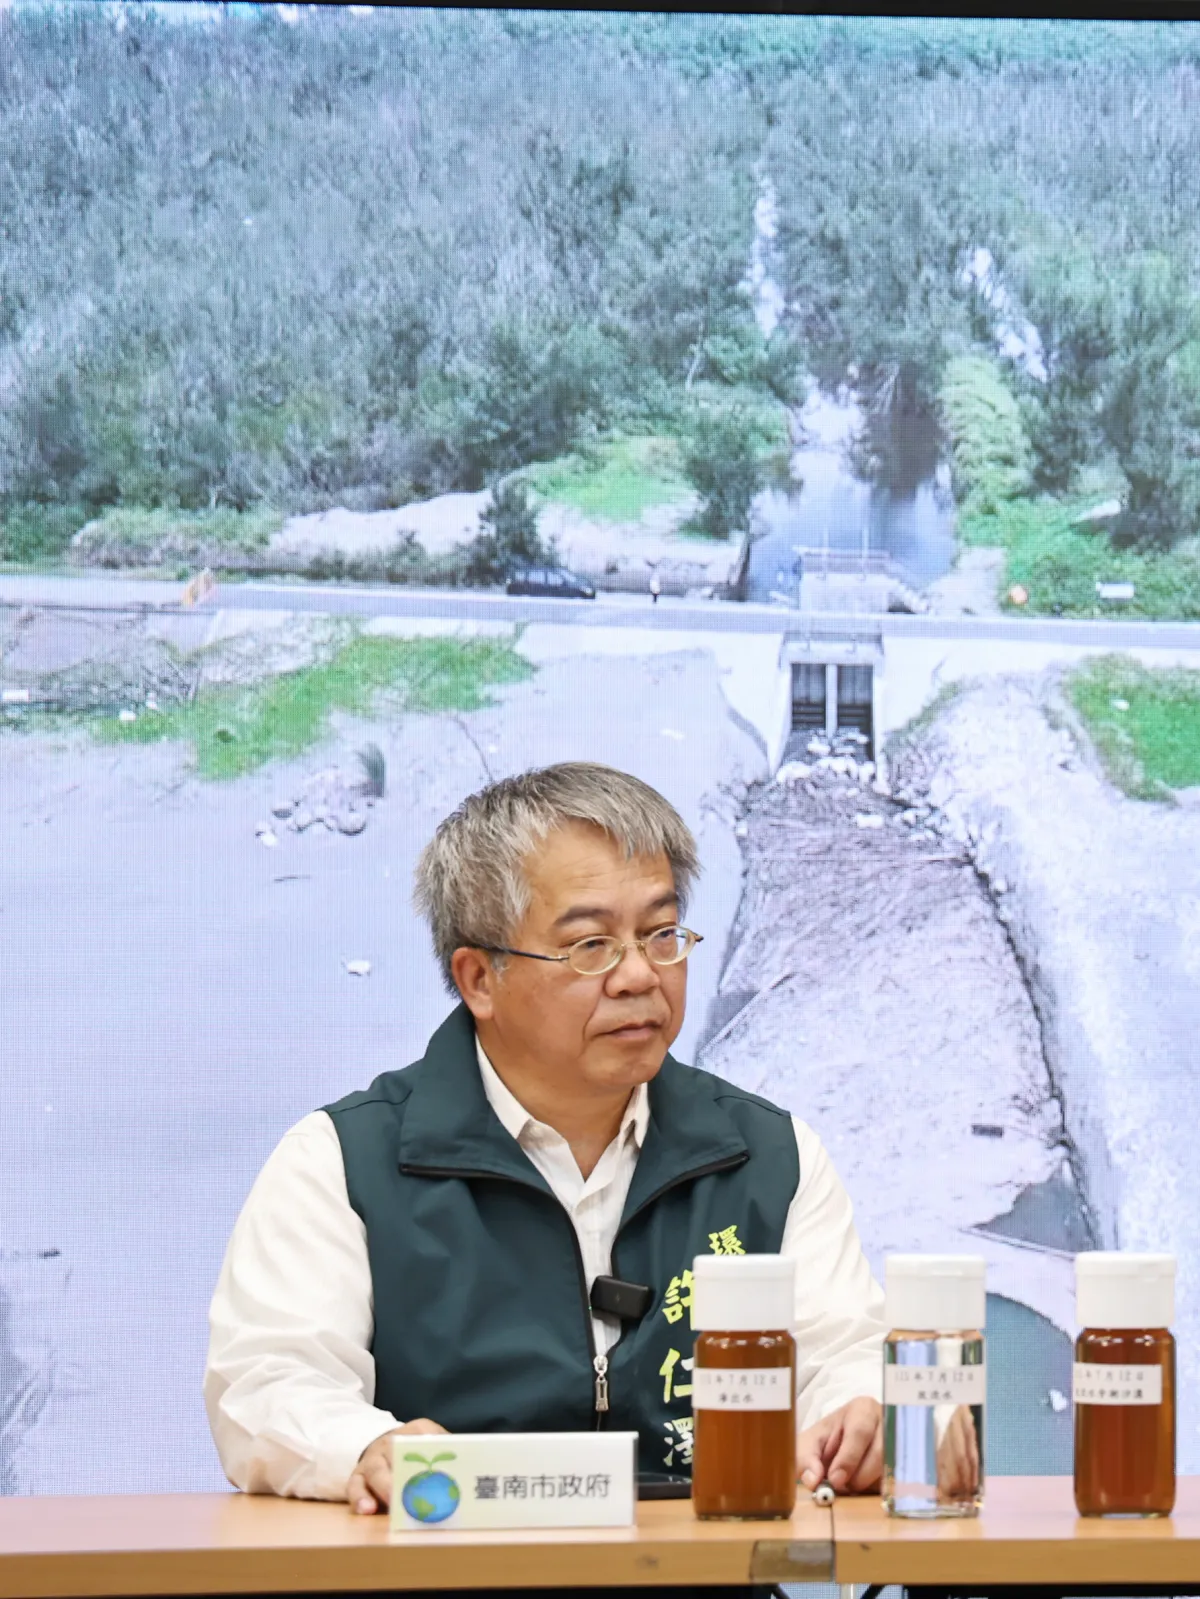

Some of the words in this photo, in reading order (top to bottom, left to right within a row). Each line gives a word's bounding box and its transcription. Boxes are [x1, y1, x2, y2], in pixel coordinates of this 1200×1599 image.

[474, 1474, 611, 1499] 臺南市政府
